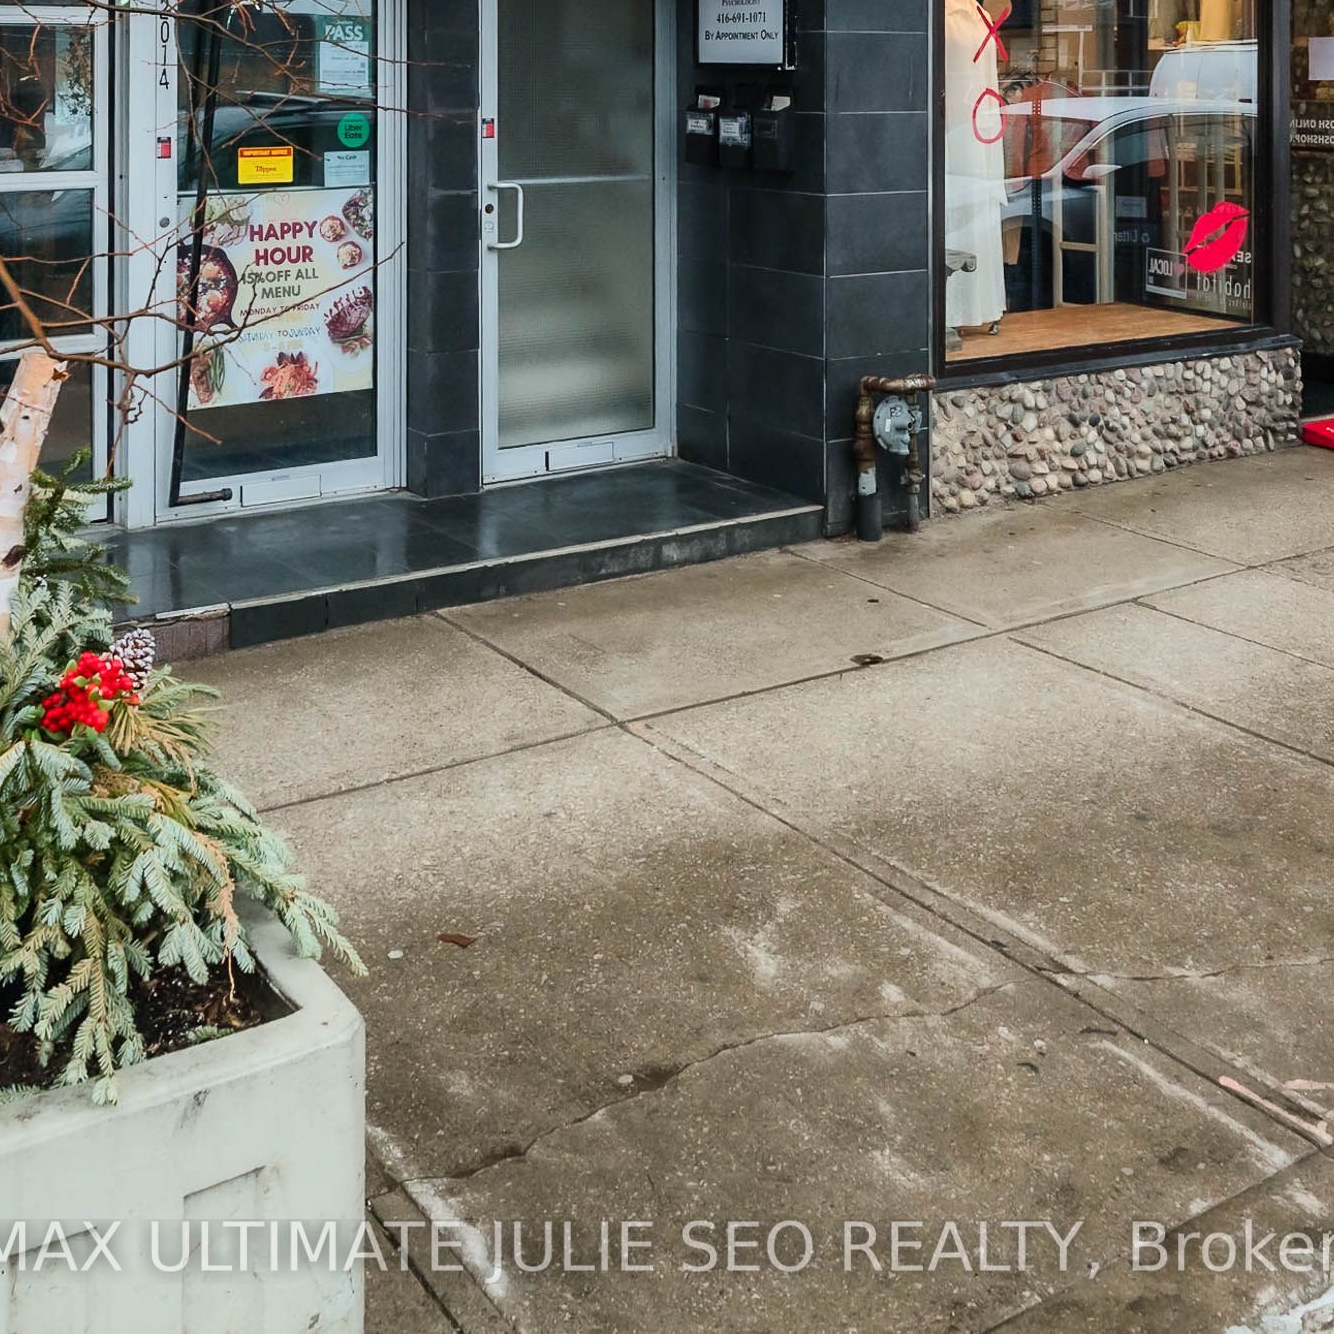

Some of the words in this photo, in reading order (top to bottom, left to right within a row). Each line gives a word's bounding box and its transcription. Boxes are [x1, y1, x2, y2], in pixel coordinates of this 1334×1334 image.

[716, 11, 766, 23] 416-691-1071
[324, 25, 364, 41] PASS
[249, 221, 318, 242] HAPPY
[254, 246, 314, 267] HOUR
[295, 268, 319, 281] ALL
[261, 285, 301, 300] MENU
